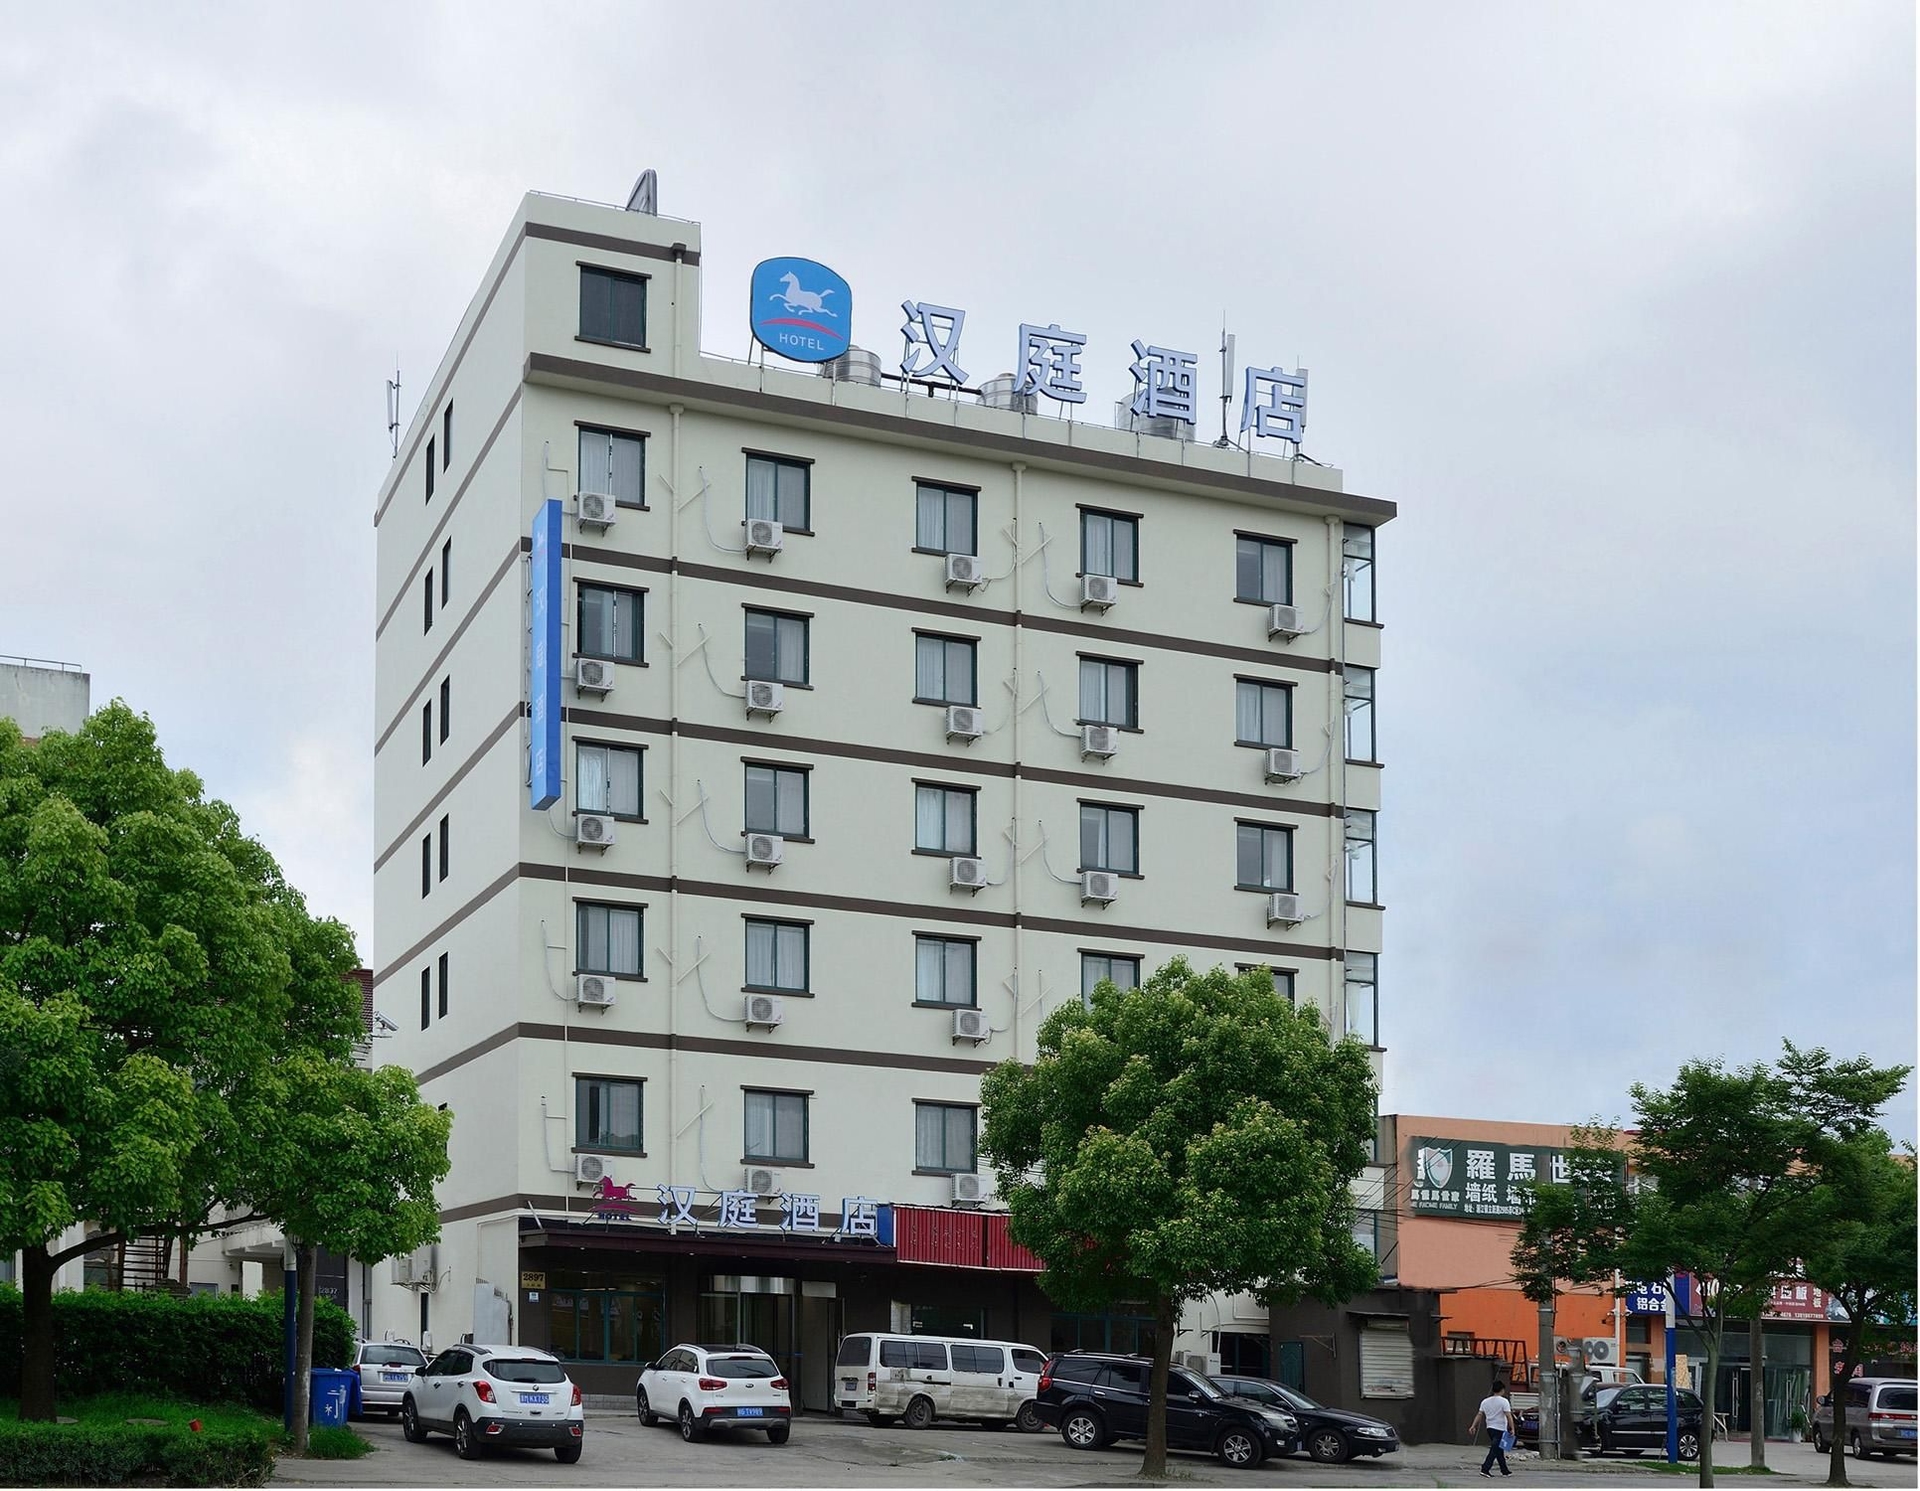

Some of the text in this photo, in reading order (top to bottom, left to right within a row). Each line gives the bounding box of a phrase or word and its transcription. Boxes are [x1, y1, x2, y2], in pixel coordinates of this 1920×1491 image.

[779, 332, 825, 351] HOTEL
[899, 300, 1308, 443] 汉庭酒店
[1465, 1182, 1498, 1204] 墙纸
[598, 1212, 632, 1222] HOTEL
[656, 1183, 879, 1236] 汉庭酒店
[523, 1273, 545, 1282] 2897
